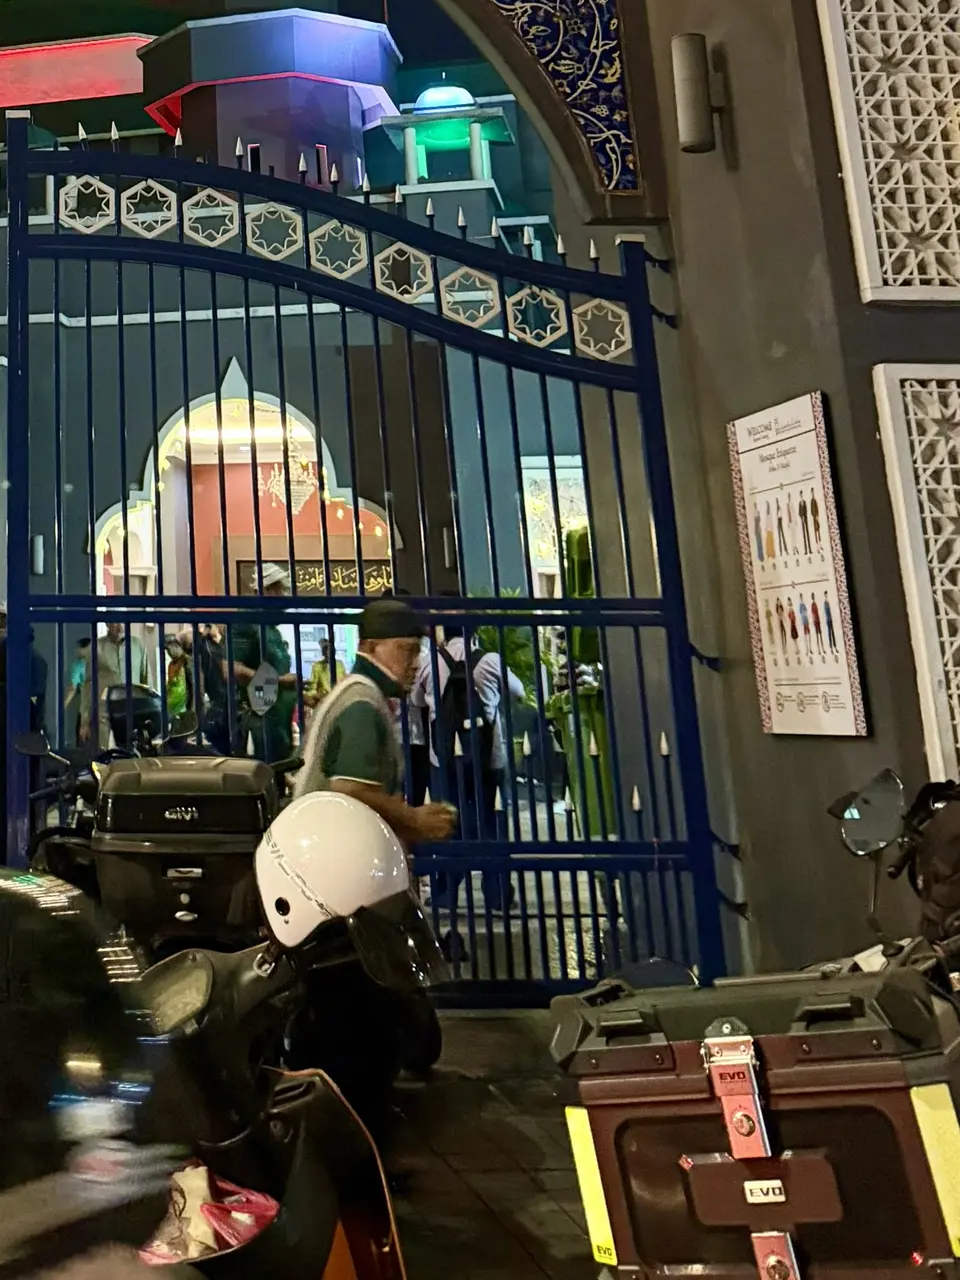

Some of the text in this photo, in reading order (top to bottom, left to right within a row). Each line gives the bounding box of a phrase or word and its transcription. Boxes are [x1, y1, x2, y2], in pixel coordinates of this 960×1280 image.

[164, 806, 199, 821] GIVI
[719, 1071, 746, 1081] EVO
[749, 1187, 784, 1197] EVO
[596, 1244, 613, 1257] EVO
